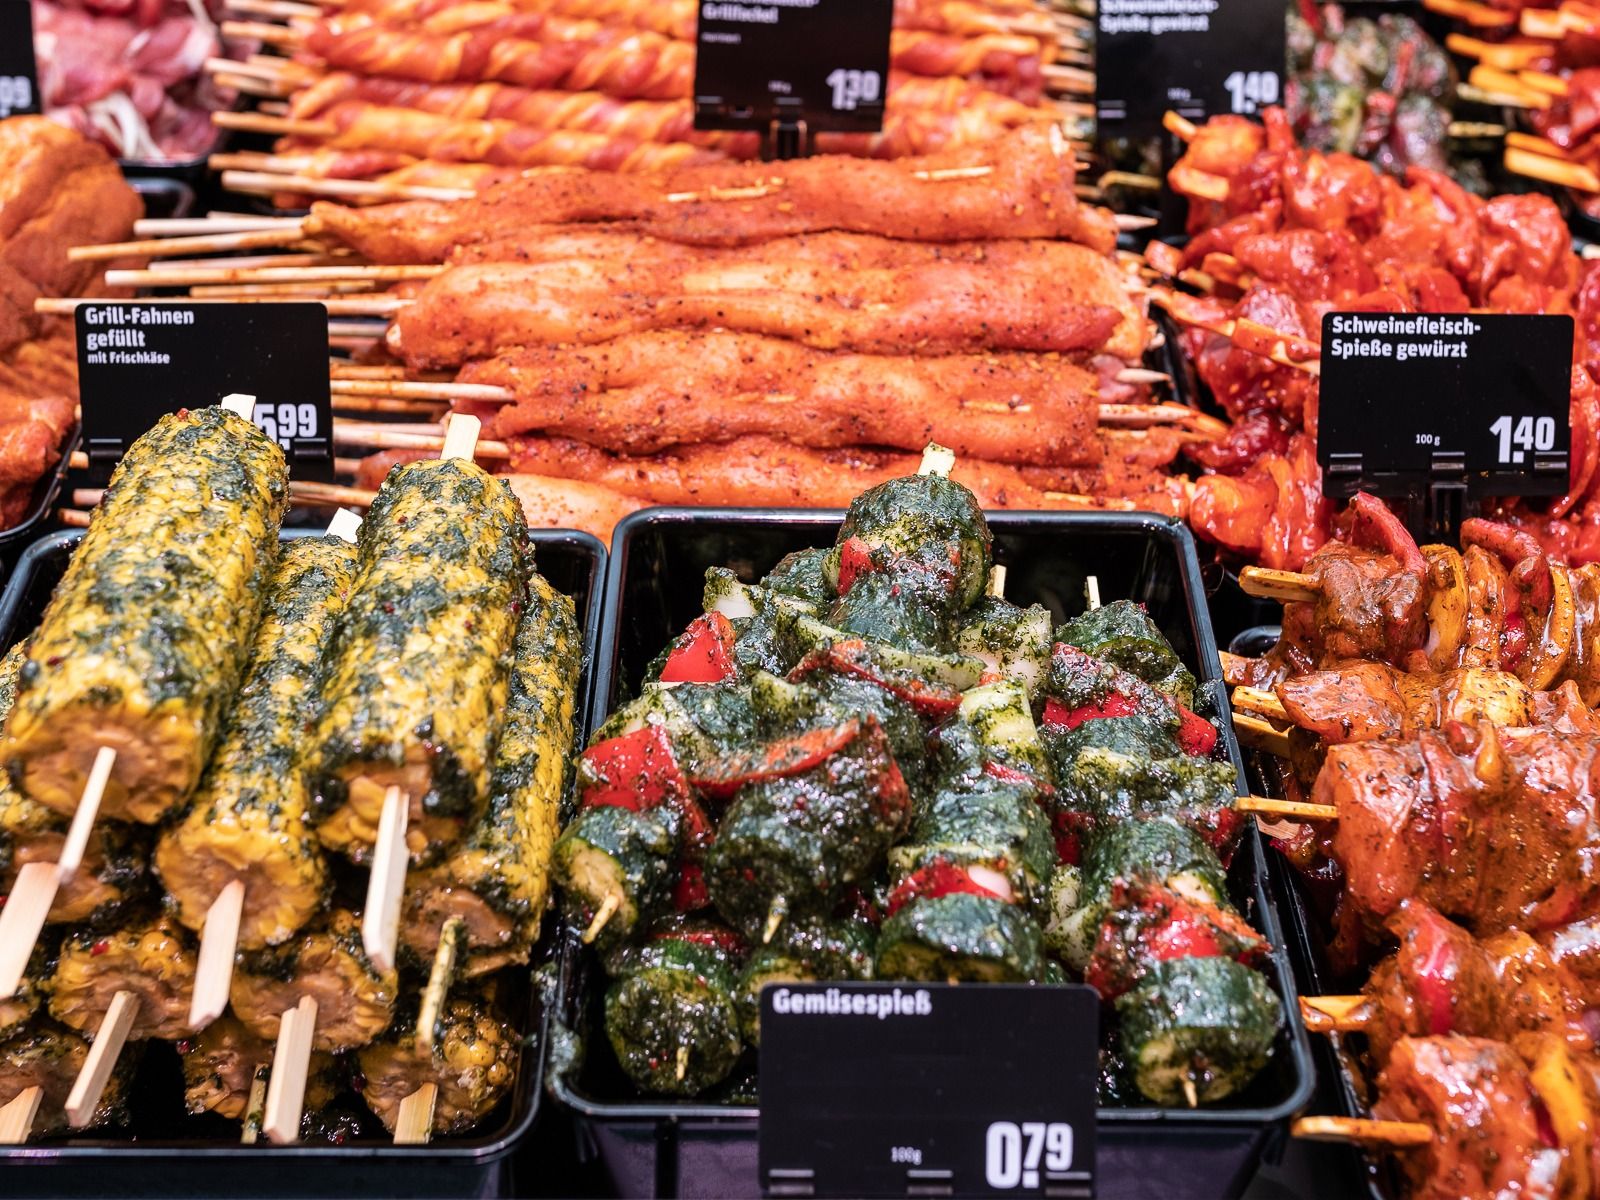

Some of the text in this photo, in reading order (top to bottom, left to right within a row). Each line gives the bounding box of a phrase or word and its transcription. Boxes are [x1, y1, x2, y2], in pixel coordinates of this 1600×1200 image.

[1224, 71, 1279, 113] 1.40
[85, 306, 194, 325] Grill-Fahnen
[1332, 315, 1481, 335] Schweinefleisch-
[86, 328, 146, 351] gefüllt
[1331, 338, 1468, 361] Spieße gewürzt
[87, 351, 171, 364] mit Frischkäse
[1415, 434, 1433, 444] 100
[1489, 415, 1556, 463] 1.40
[772, 988, 932, 1020] Gemüsespieß
[985, 1121, 1074, 1189] 0.79
